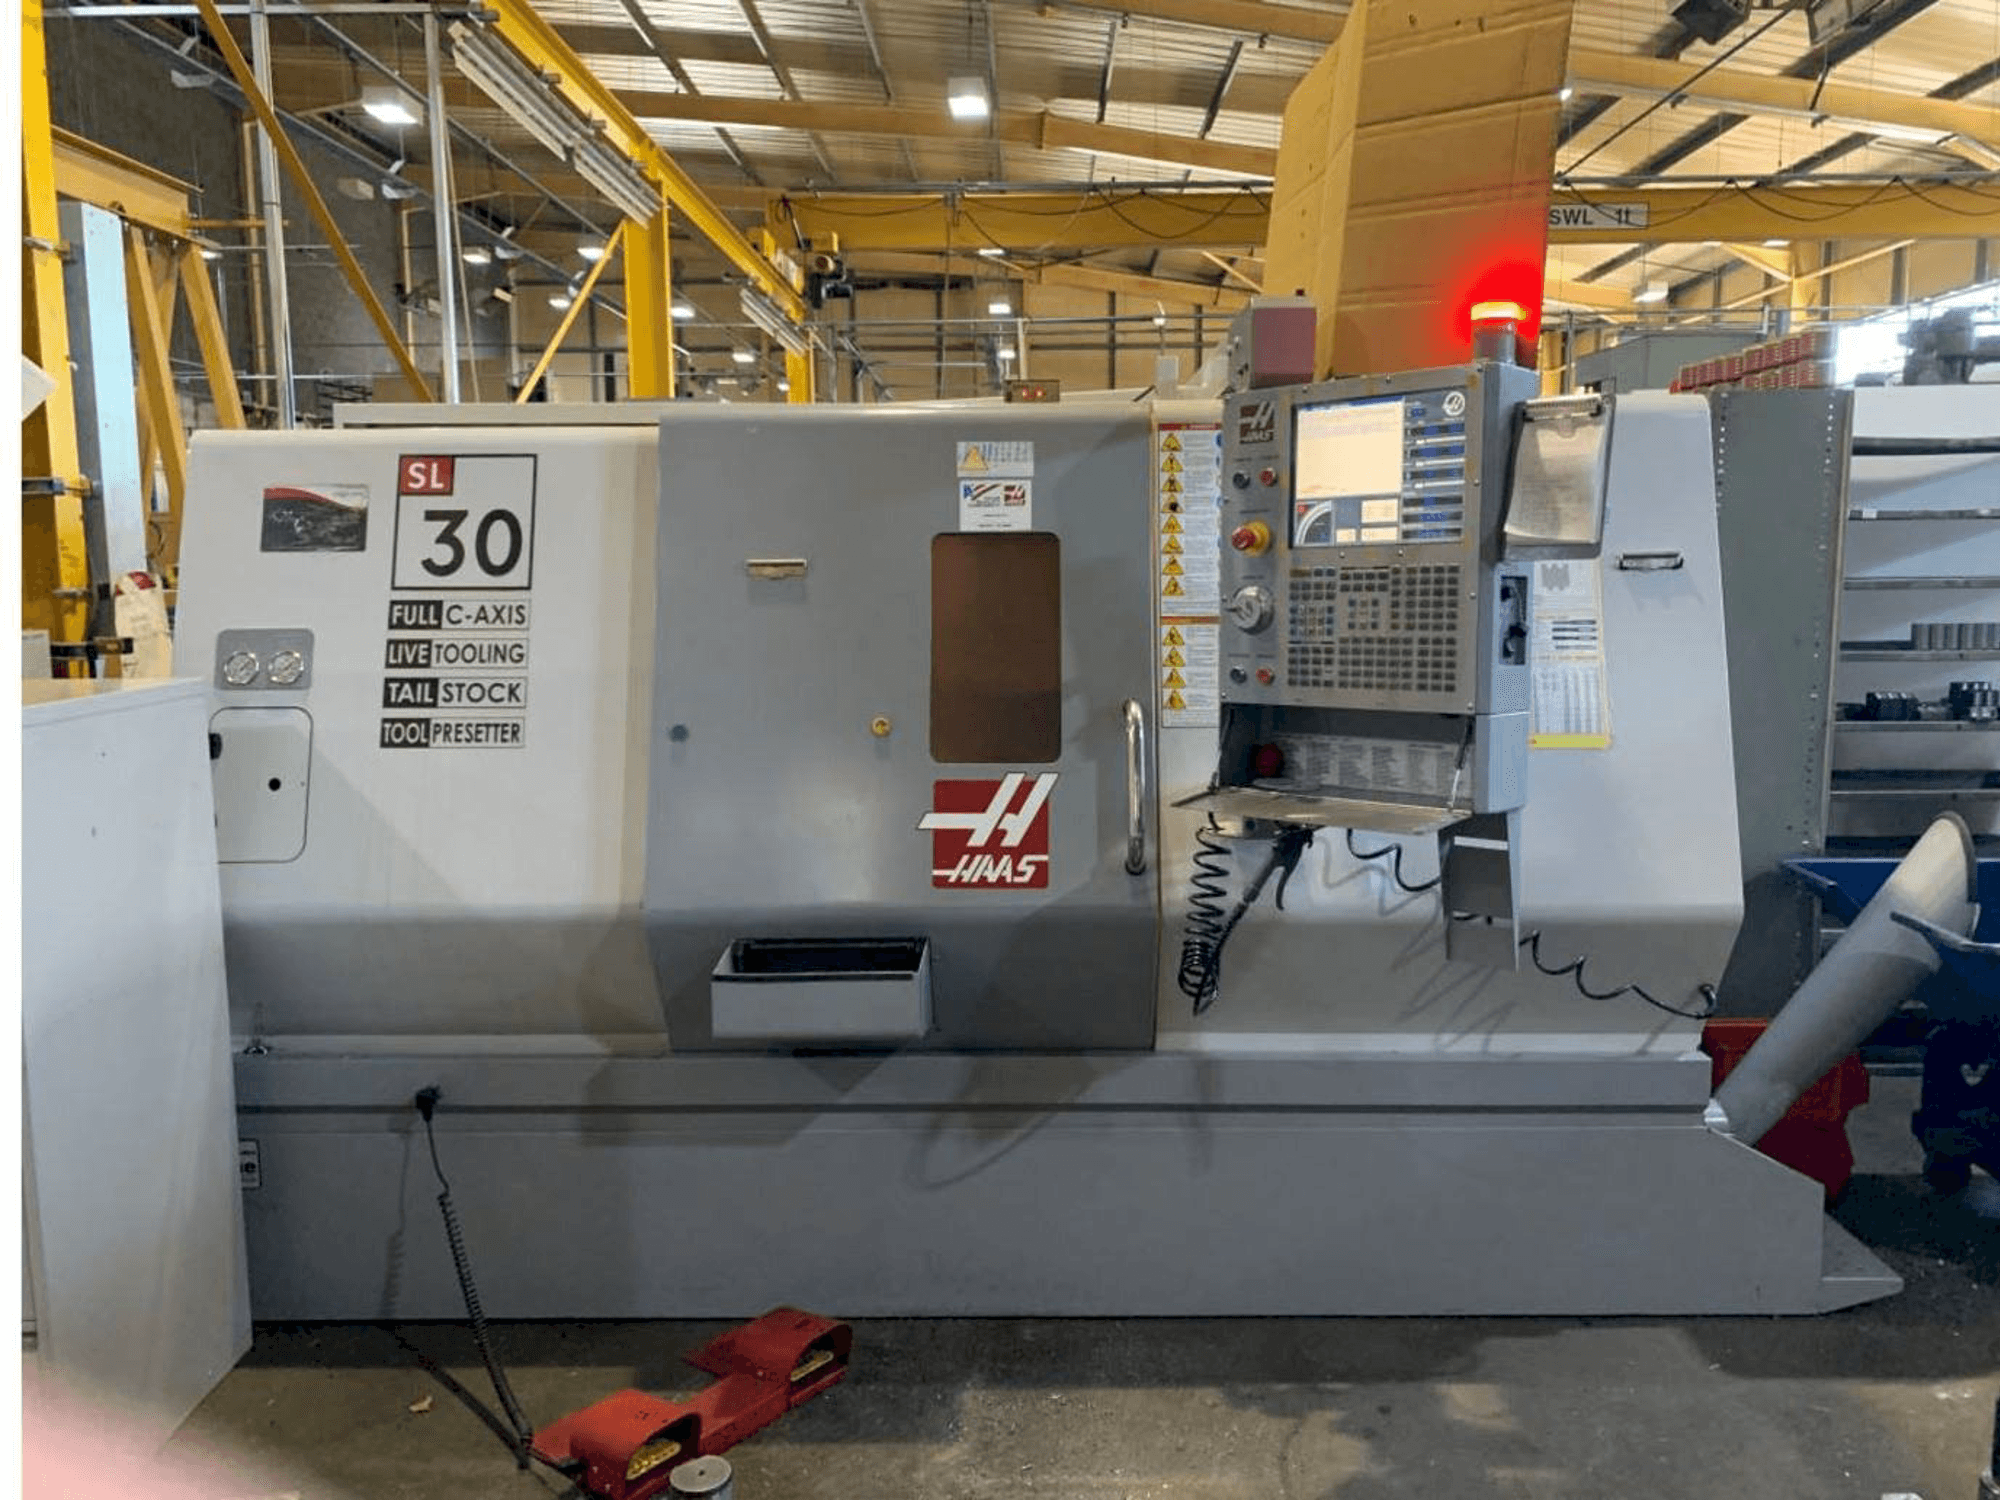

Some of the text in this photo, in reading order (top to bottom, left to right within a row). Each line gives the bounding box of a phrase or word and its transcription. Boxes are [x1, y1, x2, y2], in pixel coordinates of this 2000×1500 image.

[1549, 208, 1594, 226] SWL
[408, 462, 445, 489] SL
[421, 508, 523, 577] 30
[391, 604, 526, 625] FULL C-AXIS
[388, 643, 525, 664] LIVE TOOLING
[387, 682, 522, 703] TAIL STOCK
[383, 723, 521, 744] TOOL PRESETTER
[931, 854, 1050, 883] HAAS
